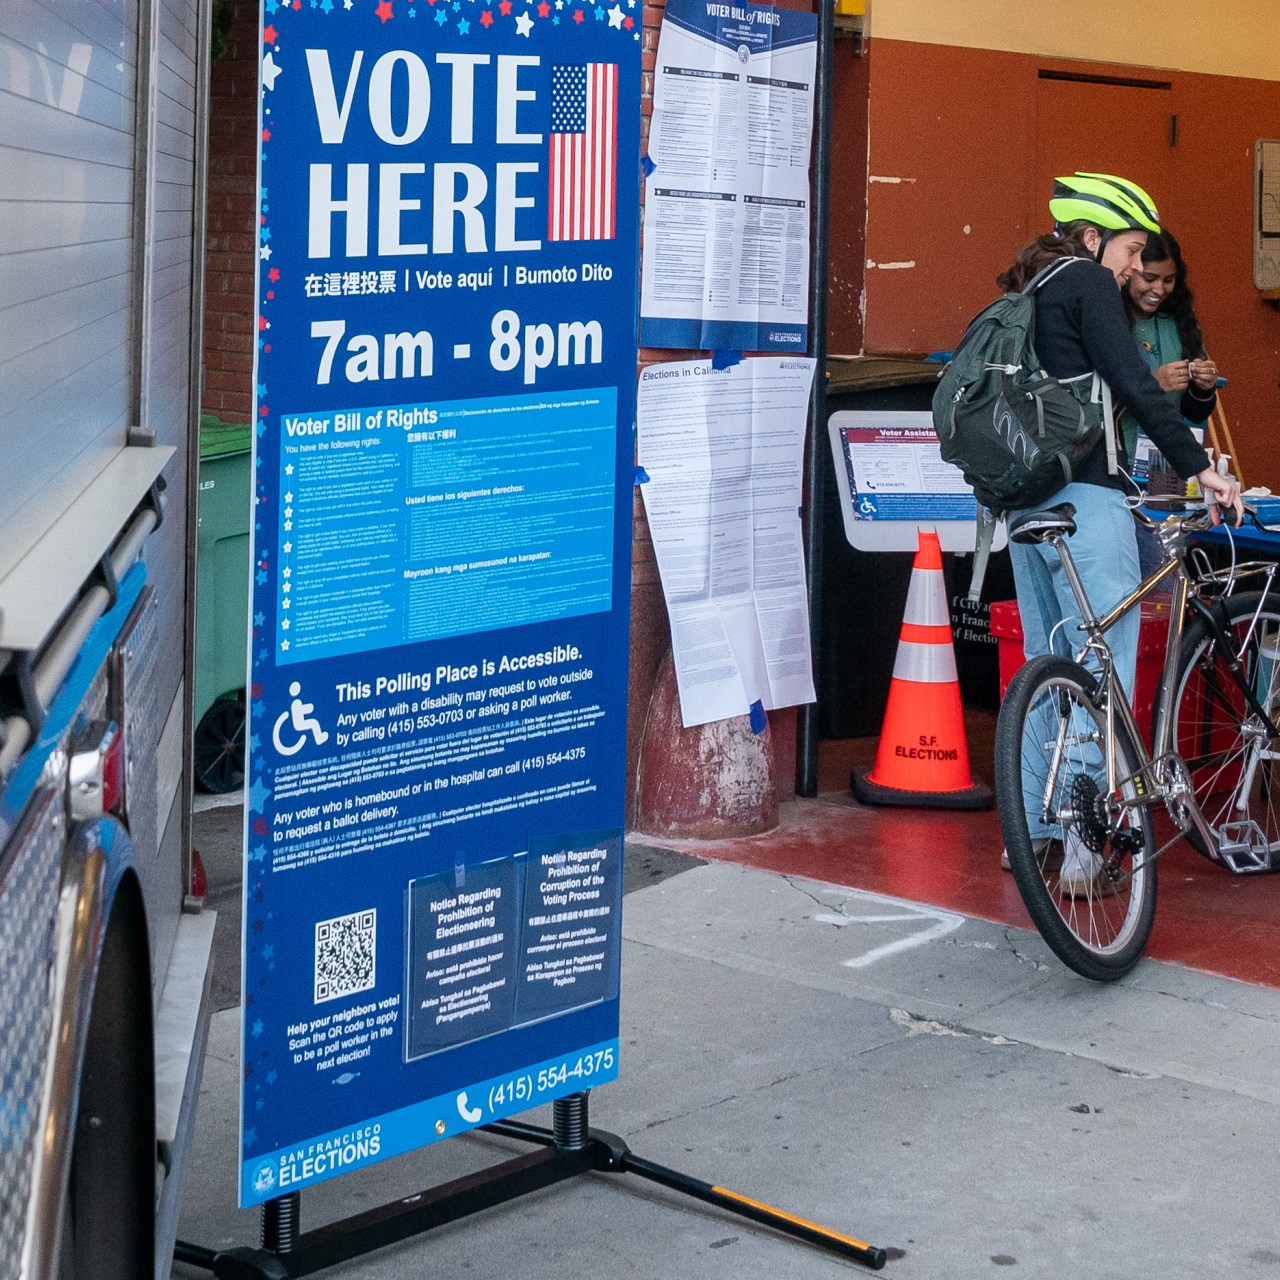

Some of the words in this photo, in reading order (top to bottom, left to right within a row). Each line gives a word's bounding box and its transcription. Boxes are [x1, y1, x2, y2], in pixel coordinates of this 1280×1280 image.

[706, 3, 730, 18] VOTER
[731, 6, 745, 20] BILL
[746, 10, 757, 24] of
[757, 10, 781, 26] RIGHTS
[305, 48, 542, 145] VOTE
[308, 162, 541, 258] HERE
[304, 270, 396, 297] 在這裡投票
[416, 270, 452, 289] Vote
[457, 267, 492, 291] aquí
[516, 265, 577, 284] Bumoto
[582, 263, 612, 281] Dito
[311, 320, 433, 385] 7am
[489, 309, 602, 384] 8pm
[642, 369, 680, 381] Elections
[682, 367, 691, 376] in
[285, 418, 330, 436] Voter
[334, 412, 360, 432] Bill
[365, 410, 382, 429] of
[386, 408, 437, 430] Rights
[285, 445, 298, 453] You
[330, 440, 360, 449] following
[361, 438, 381, 447] rights:
[405, 495, 425, 505] Usted
[445, 492, 455, 500] los
[456, 489, 491, 500] siguientes
[492, 485, 525, 494] derechos:
[403, 568, 433, 579] Mayroon
[434, 566, 451, 574] kang
[452, 563, 467, 572] mga
[468, 556, 507, 569] sumusunod
[518, 552, 551, 561] karapatan:
[962, 613, 991, 628] Franc
[964, 629, 998, 644] Electio
[336, 681, 371, 702] This
[376, 672, 431, 695] Polling
[436, 665, 478, 684] Place
[482, 659, 495, 676] is
[498, 644, 582, 673] Accessible.
[337, 713, 357, 727] Any
[360, 708, 386, 721] voter
[388, 702, 409, 716] with
[411, 702, 418, 712] a
[420, 692, 463, 710] disability
[465, 689, 486, 702] may
[489, 680, 524, 698] request
[526, 679, 536, 690] to
[538, 675, 557, 688] vote
[560, 668, 593, 684] outside
[337, 732, 349, 747] by
[352, 726, 385, 741] calling
[387, 718, 414, 737] (415)
[417, 708, 463, 729] 553-0703
[465, 709, 476, 719] or
[478, 702, 509, 717] asking
[511, 700, 518, 710] a
[520, 695, 537, 711] poll
[539, 690, 572, 704] worker.
[895, 745, 958, 761] ELECTIONS
[919, 735, 939, 747] S.F.
[273, 812, 293, 825] Any
[295, 806, 320, 820] voter
[322, 801, 342, 814] who
[344, 798, 352, 809] is
[355, 784, 409, 806] homebound
[411, 784, 421, 794] or
[423, 781, 432, 791] in
[434, 778, 448, 789] the
[451, 768, 485, 785] hospital
[487, 767, 503, 778] can
[505, 761, 520, 774] call
[522, 756, 544, 772] (415)
[546, 746, 585, 765] 554-4375
[273, 831, 283, 842] to
[285, 821, 322, 839] request
[324, 820, 330, 830] a
[333, 812, 358, 828] ballot
[361, 806, 398, 822] delivery.
[541, 853, 566, 865] Notice
[567, 848, 606, 865] Regarding
[548, 864, 589, 877] Prohibition
[591, 861, 600, 872] of
[539, 878, 581, 892] Corruption
[582, 875, 591, 886] of
[592, 875, 604, 885] the
[430, 898, 456, 912] Notice
[458, 887, 501, 905] Regarding
[543, 894, 567, 905] Voting
[568, 890, 599, 901] Process
[438, 905, 483, 924] Prohibition
[484, 900, 493, 912] of
[436, 916, 495, 939] Electioneering
[287, 1022, 308, 1036] Help
[310, 1016, 330, 1031] your
[332, 1003, 376, 1023] neighbors
[378, 994, 399, 1009] vote!
[289, 1037, 310, 1050] Scan
[312, 1032, 326, 1043] the
[328, 1025, 342, 1038] QR
[344, 1020, 364, 1033] code
[366, 1018, 374, 1027] to
[376, 1010, 398, 1024] apply
[294, 1054, 302, 1063] to
[304, 1050, 315, 1060] be
[317, 1047, 322, 1056] a
[324, 1040, 339, 1056] poll
[341, 1033, 369, 1048] worker
[370, 1030, 378, 1040] in
[380, 1026, 393, 1037] the
[316, 1057, 334, 1070] next
[336, 1045, 370, 1065] election!
[488, 1075, 532, 1112] (415)
[537, 1048, 613, 1091] 554-4375
[280, 1150, 303, 1165] SAN
[308, 1123, 380, 1154] FRANCISCO
[279, 1136, 380, 1187] ELECTIONS
